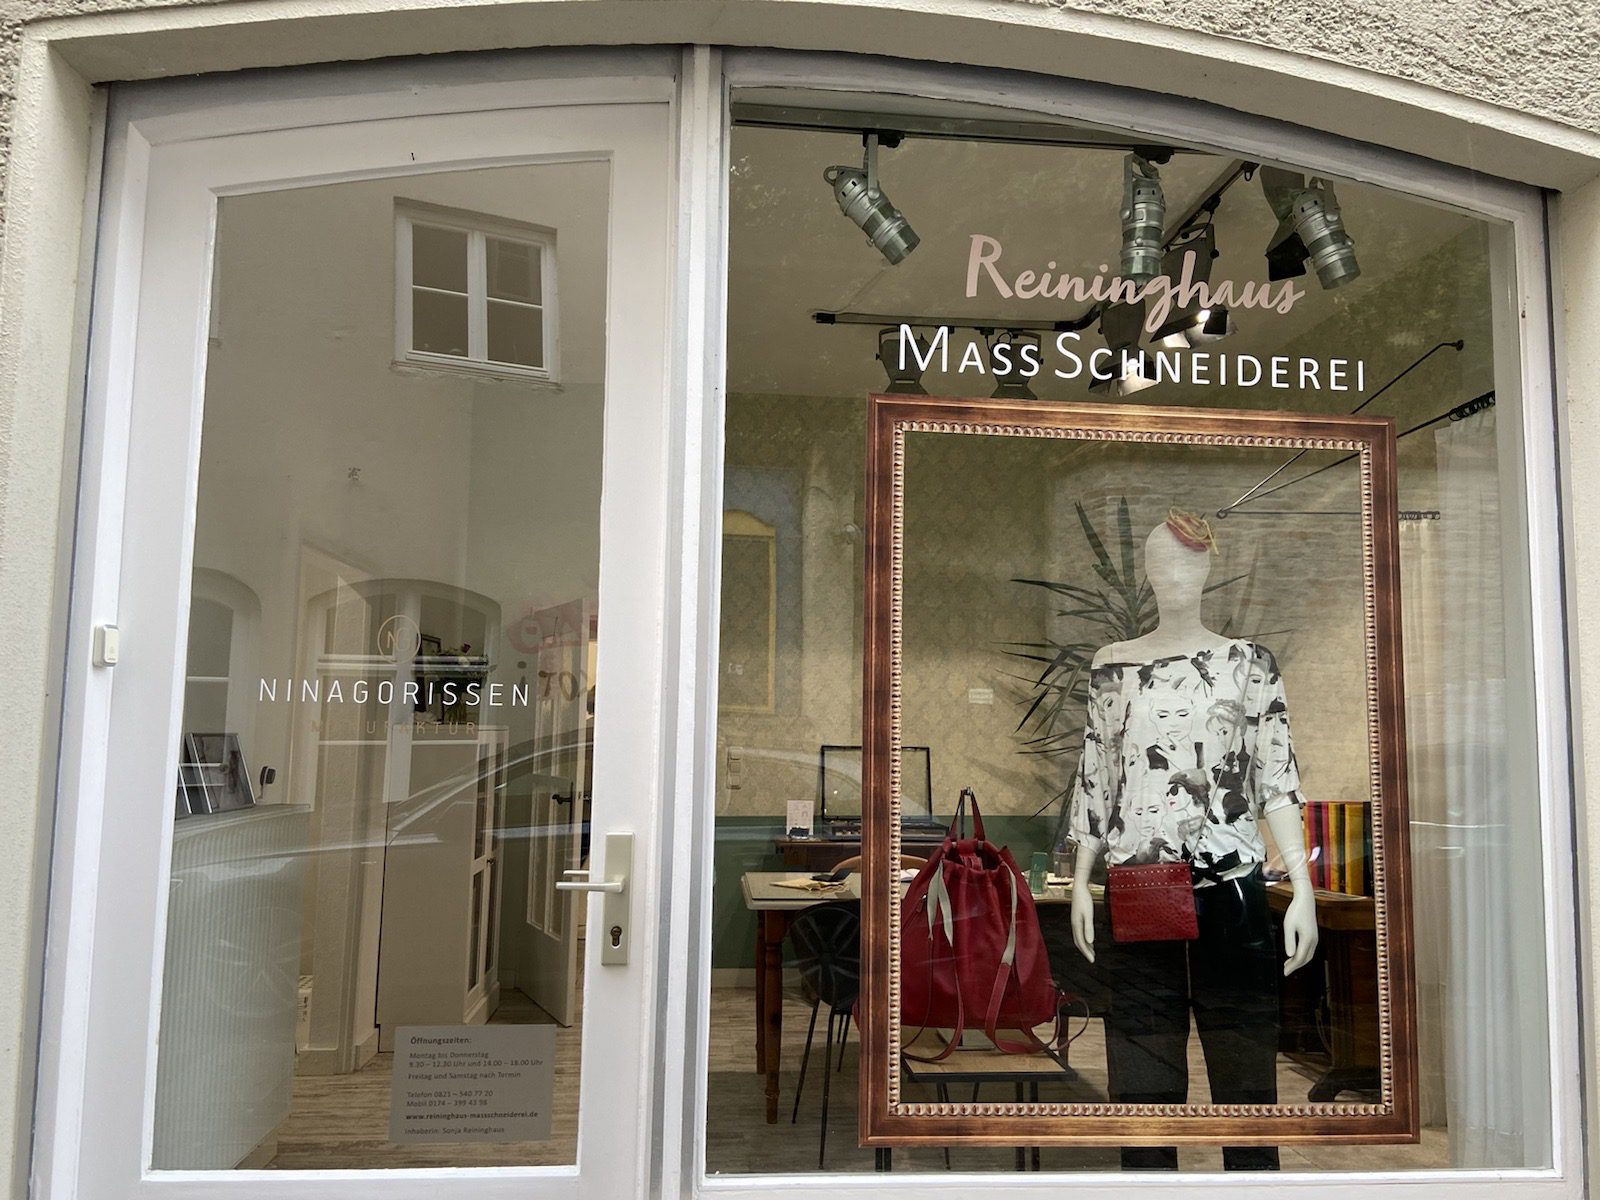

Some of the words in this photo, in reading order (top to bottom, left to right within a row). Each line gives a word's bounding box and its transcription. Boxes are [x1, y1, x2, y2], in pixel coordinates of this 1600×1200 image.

[965, 233, 1306, 333] Reininghaus
[897, 323, 1041, 378] MASS
[1054, 331, 1366, 392] SCHNEIDEREI
[258, 677, 530, 707] NINAGORISSEN
[410, 1036, 472, 1046] Öffnungszeiten:
[409, 1052, 436, 1060] Montag
[437, 1051, 448, 1059] bis
[450, 1051, 489, 1059] Donnerstag
[408, 1072, 432, 1081] Freitag
[449, 1072, 478, 1080] Samstag
[442, 1127, 462, 1135] Sonja
[463, 1126, 505, 1134] Reininghaus
